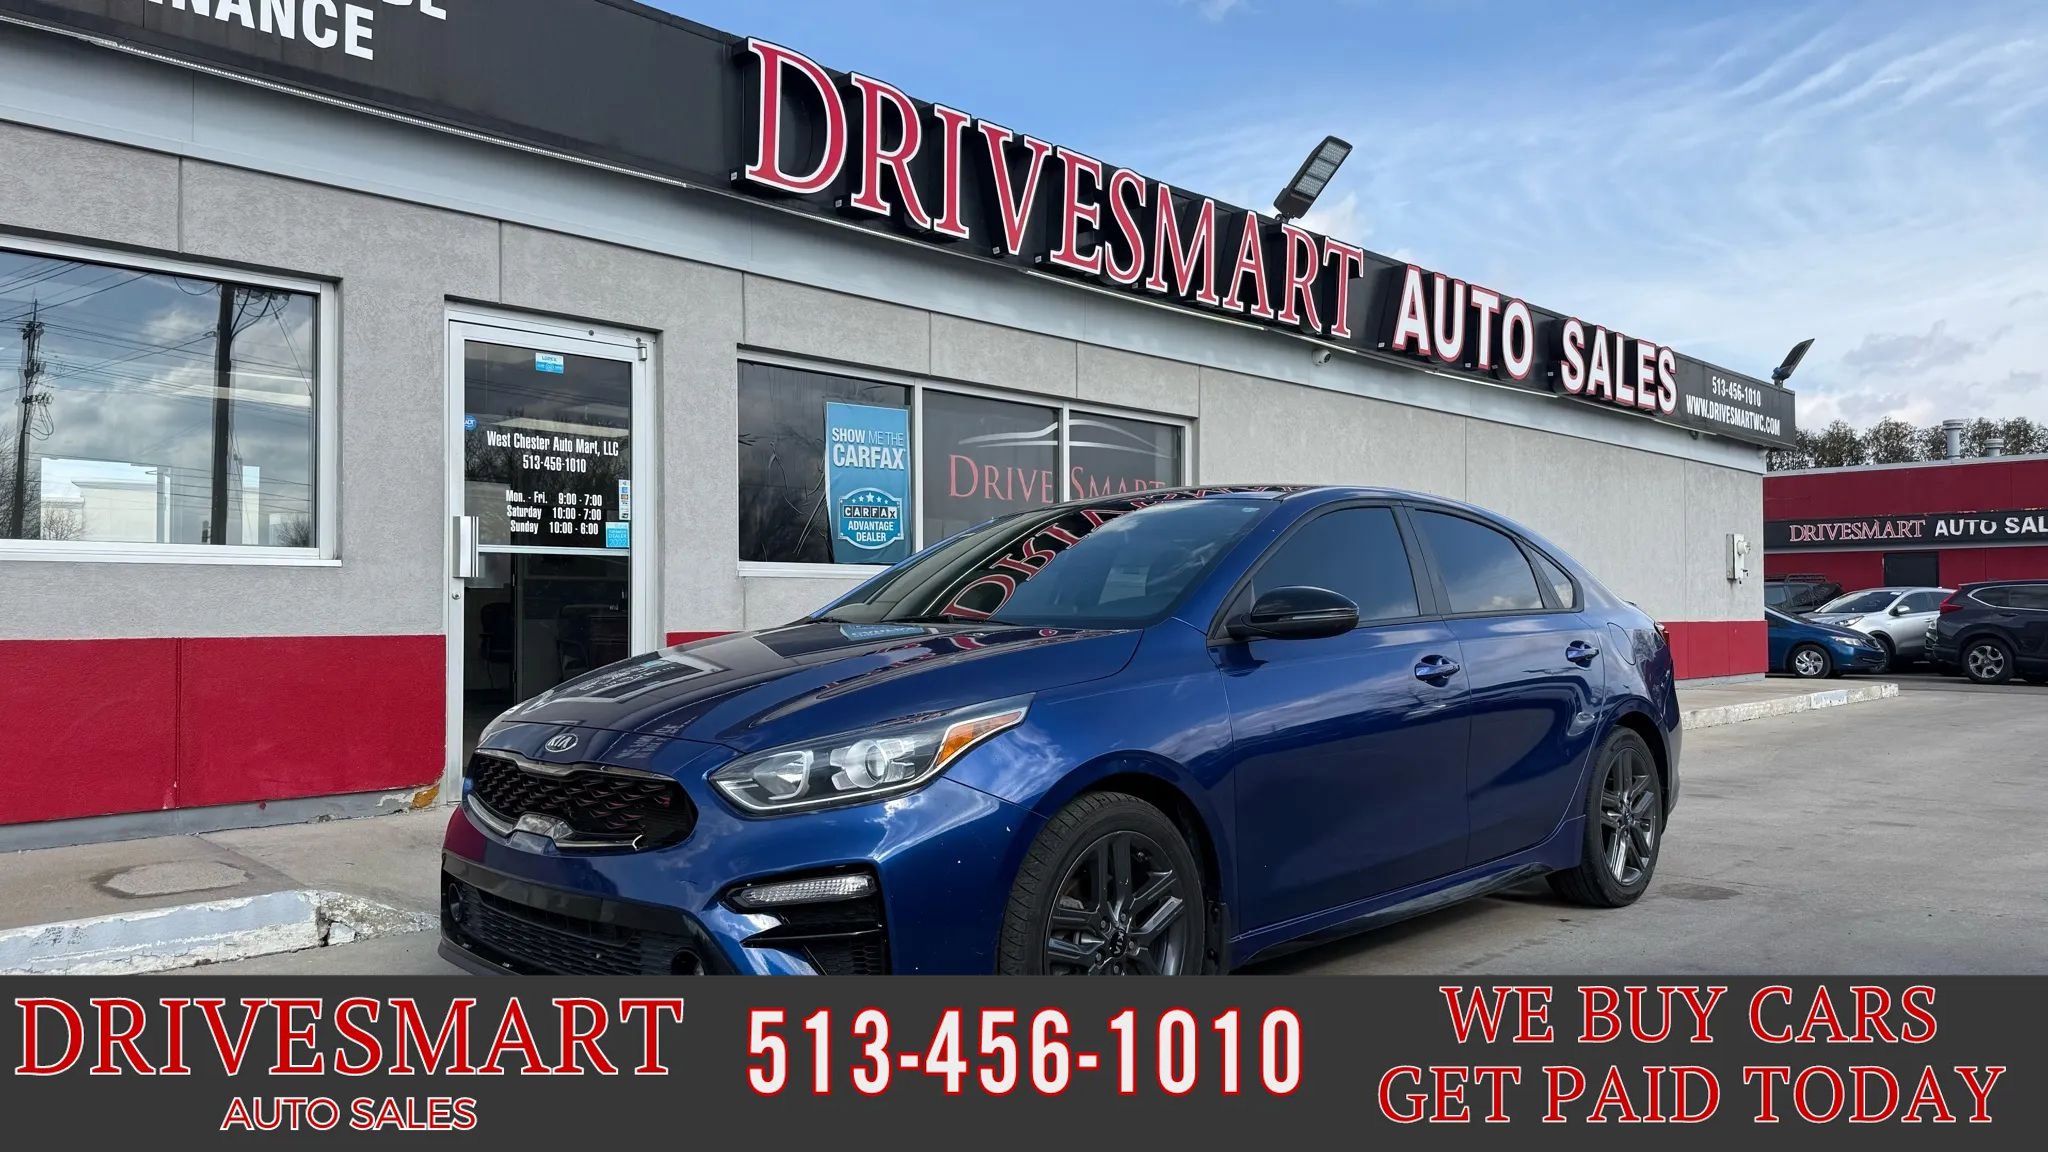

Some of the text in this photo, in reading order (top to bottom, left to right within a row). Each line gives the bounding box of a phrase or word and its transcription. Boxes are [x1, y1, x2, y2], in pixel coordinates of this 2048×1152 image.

[148, 0, 374, 60] ANCE
[745, 36, 1678, 416] DRIVESMART AUTO SALES
[1712, 376, 1761, 407] 513-456-1010
[1686, 394, 1780, 436] WWW.DRIVESMARTWC.COM
[487, 430, 619, 456] West Chester Auto Mart, LLC
[831, 427, 904, 447] SHOW ME THE
[522, 454, 586, 473] 513-456-1010
[832, 444, 905, 470] CARFAX
[948, 454, 1166, 504] DRIVE SMA
[505, 489, 525, 503] Mon.
[533, 491, 548, 504] Fri.
[558, 493, 577, 505] 9:00
[584, 494, 602, 506] 7:00
[506, 504, 542, 520] Saturday
[552, 507, 576, 520] 10:00
[583, 508, 602, 521] 7:00
[844, 505, 897, 519] CARFAX
[510, 519, 539, 535] Sunday
[549, 521, 573, 534] 10:00
[580, 522, 599, 535] 6:00
[848, 520, 894, 531] ADVANTAGE
[856, 531, 887, 542] DEALER
[1789, 516, 2048, 542] DRIVESMART AUTO SAL
